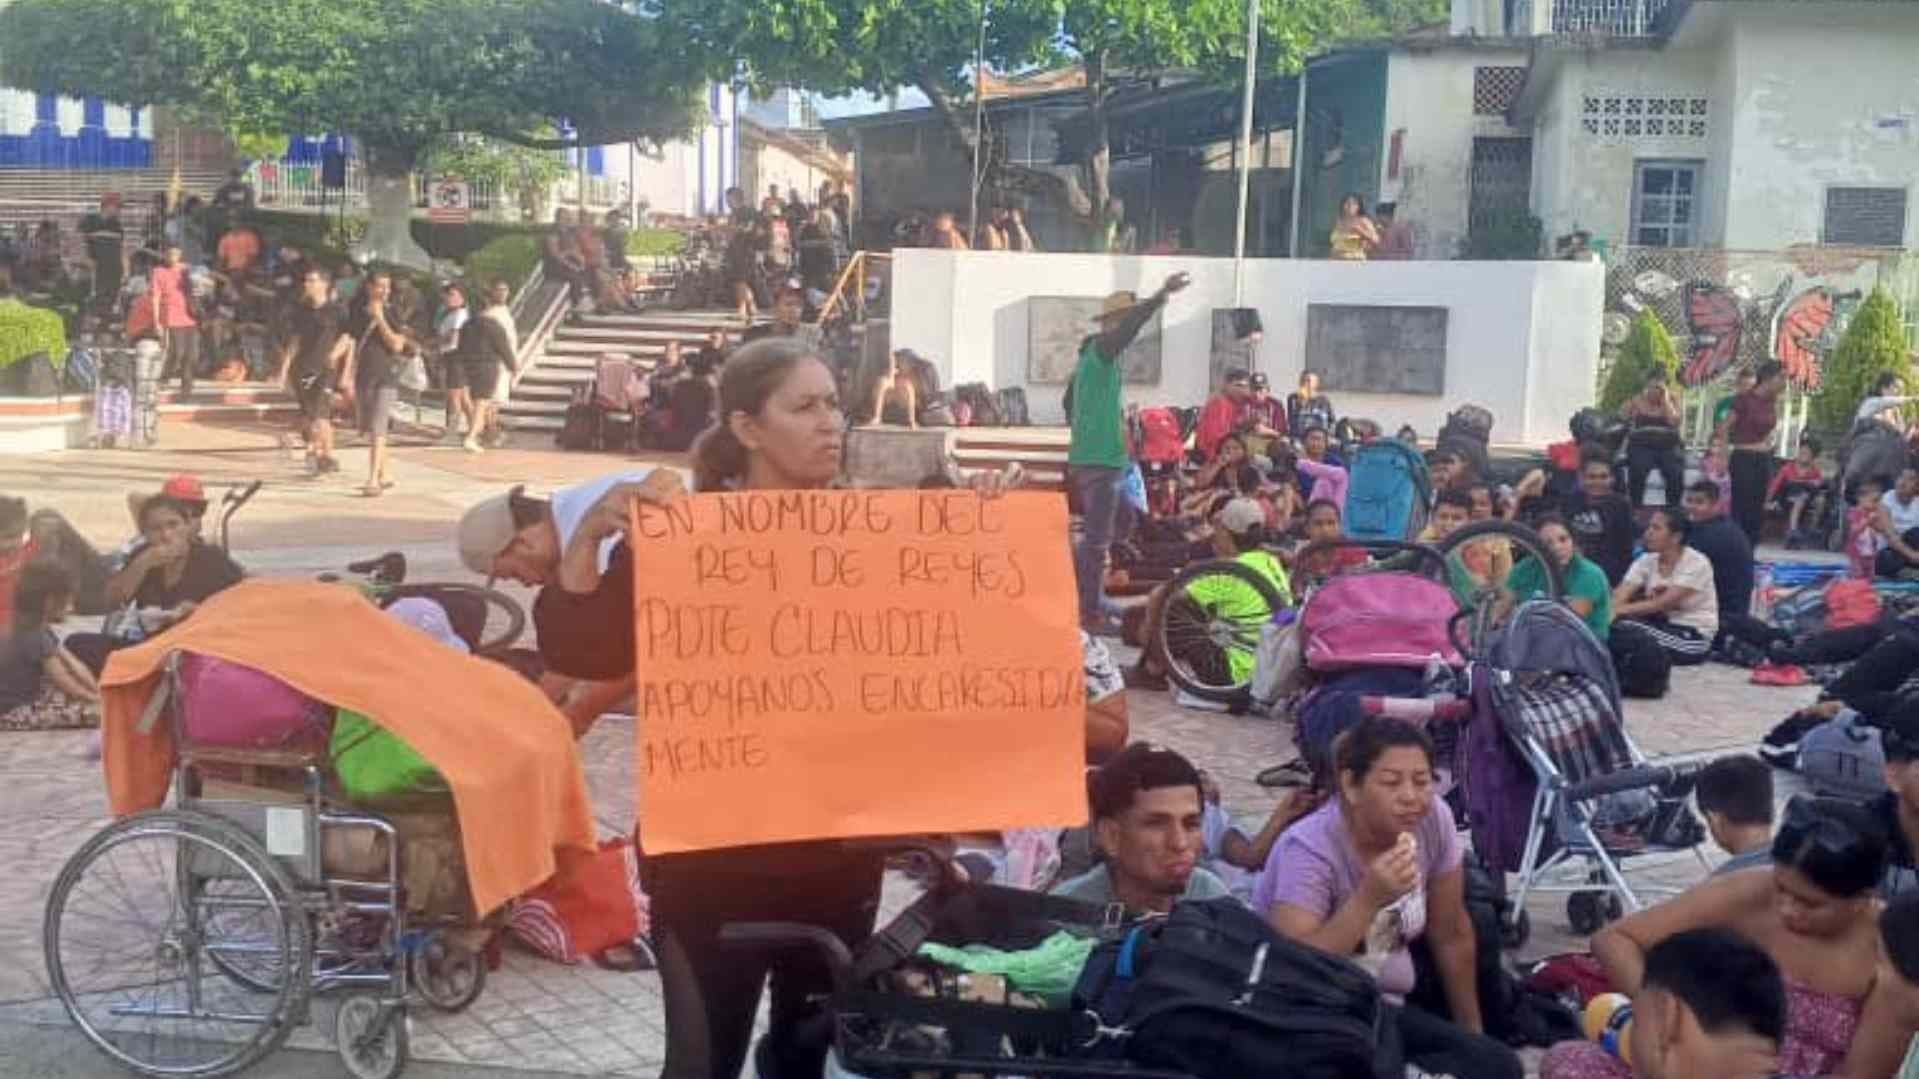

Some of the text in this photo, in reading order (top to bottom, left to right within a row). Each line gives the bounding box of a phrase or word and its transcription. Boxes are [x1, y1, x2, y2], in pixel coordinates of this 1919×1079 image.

[637, 493, 1005, 539] EN NOMBRE DEL
[696, 544, 1026, 600] REY DE REYES
[643, 597, 963, 660] PDTE CLAUDIA
[644, 667, 835, 728] APOYANOS
[646, 734, 769, 780] MENTE
